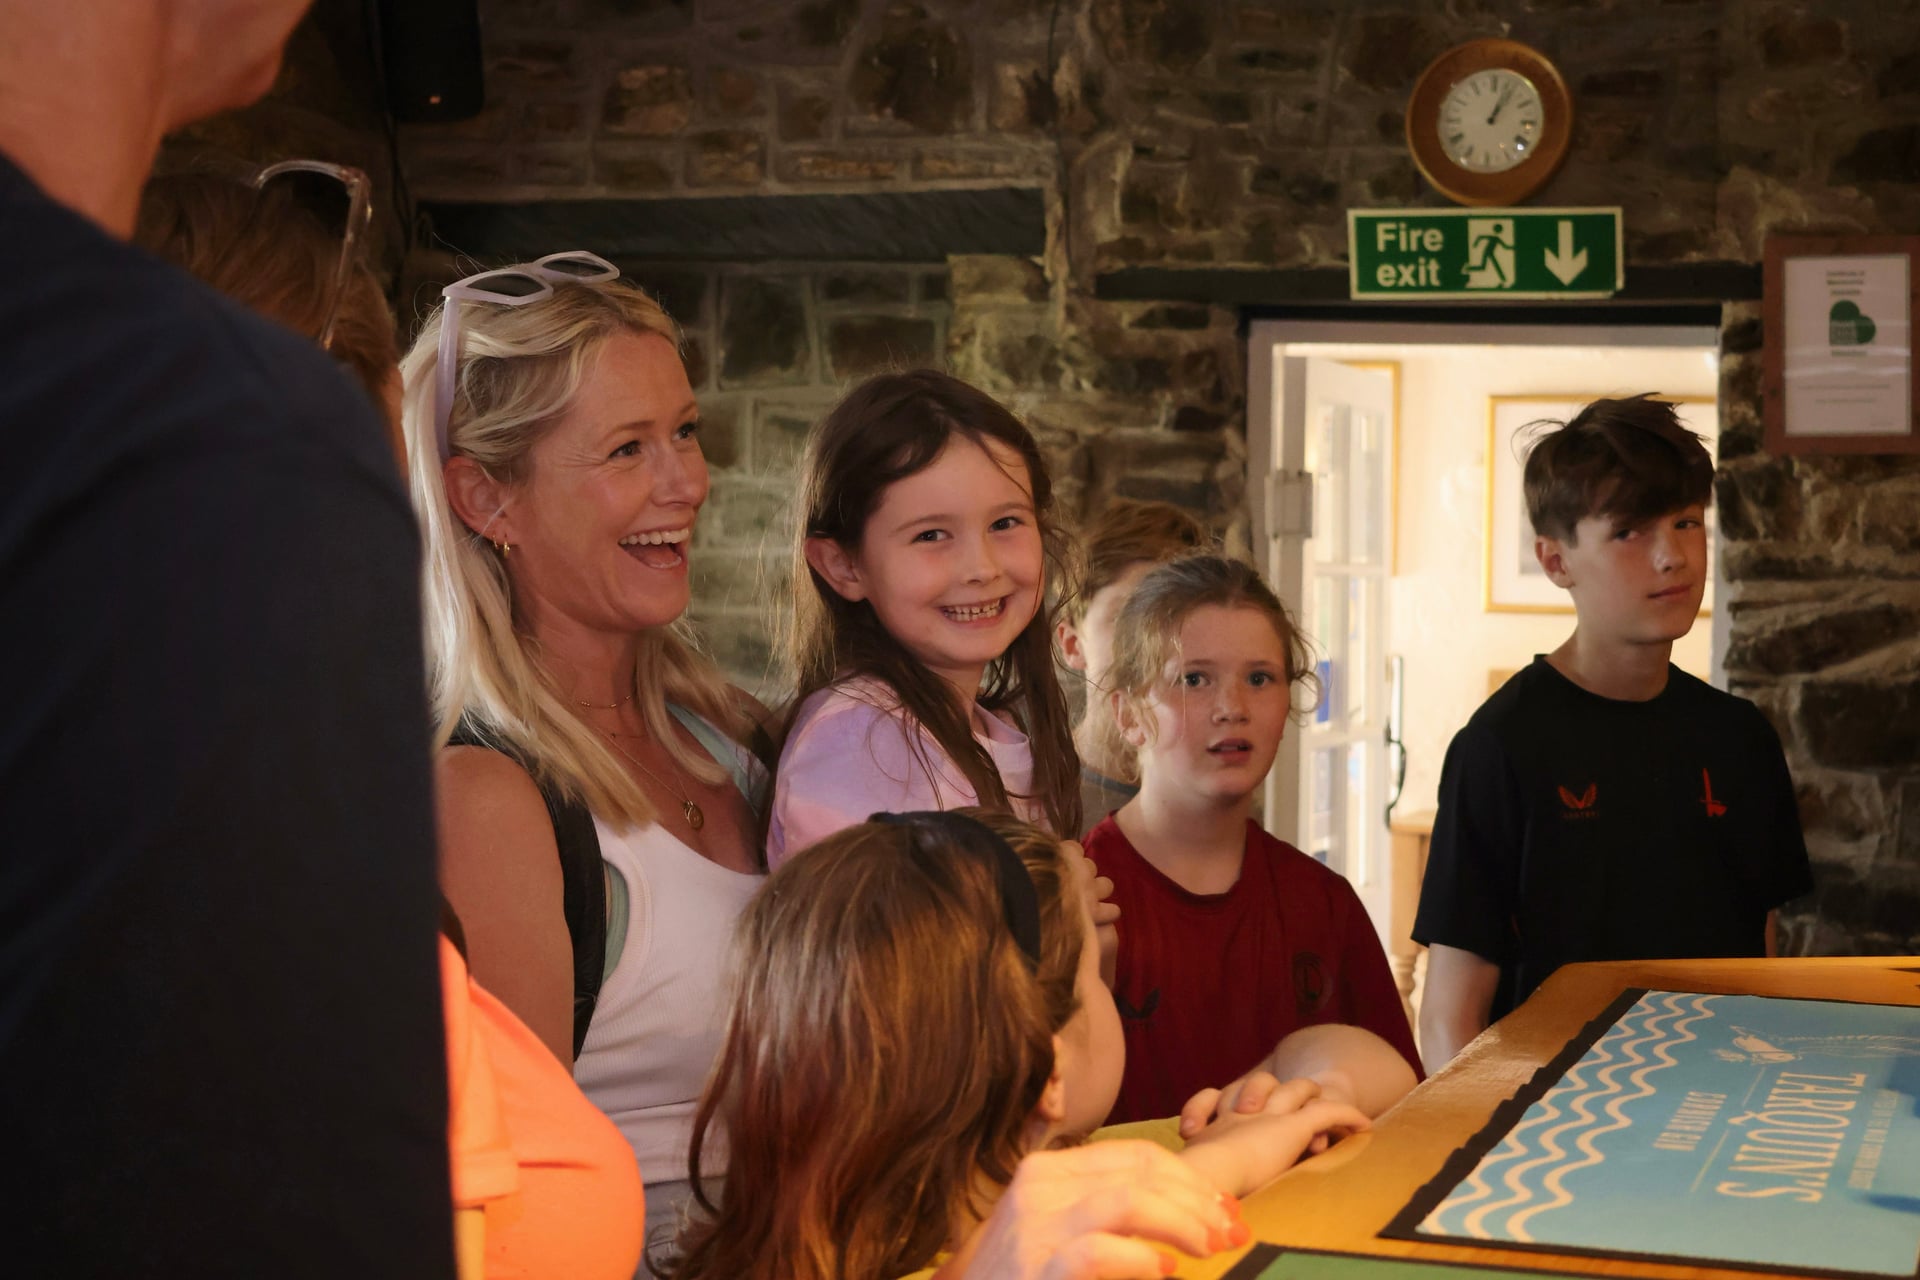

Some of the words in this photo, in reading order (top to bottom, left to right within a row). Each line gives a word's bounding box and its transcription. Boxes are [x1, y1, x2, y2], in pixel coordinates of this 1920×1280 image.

[1376, 222, 1444, 252] Fire
[1376, 258, 1441, 287] exit
[1716, 1072, 1868, 1203] TARQUIN'S
